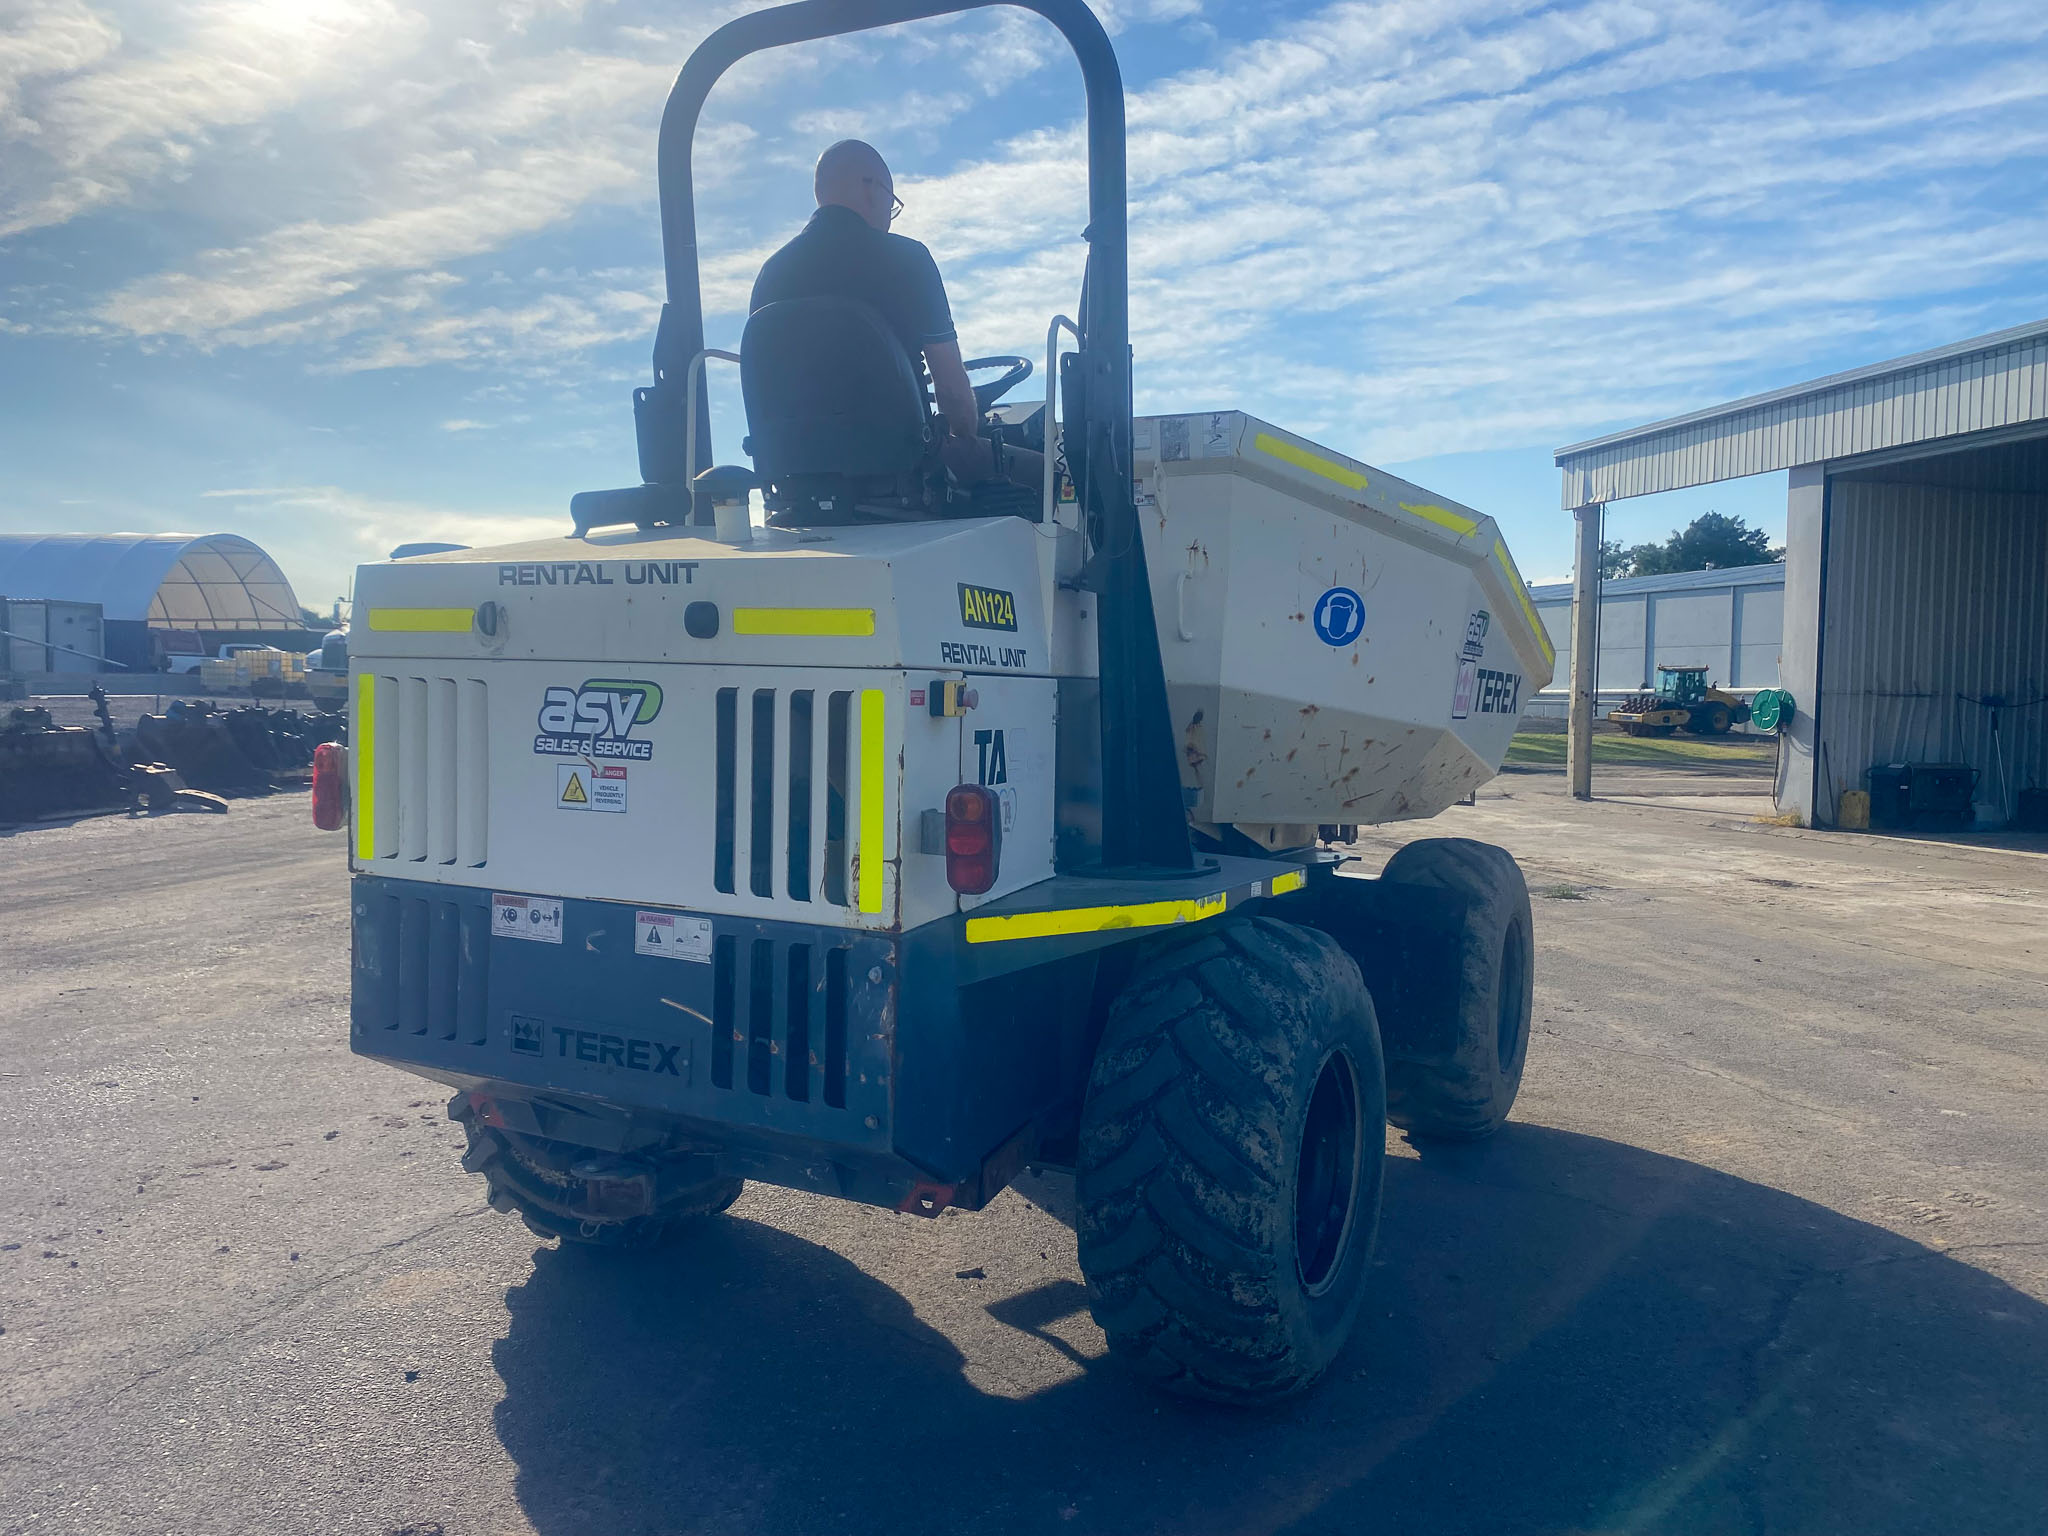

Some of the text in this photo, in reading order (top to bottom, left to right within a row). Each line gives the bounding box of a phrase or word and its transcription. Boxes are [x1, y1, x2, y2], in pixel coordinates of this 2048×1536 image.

[498, 562, 699, 586] RENTAL UNIT
[964, 587, 1014, 626] AN124
[940, 641, 1027, 668] RENTAL UNIT
[1474, 668, 1522, 714] TEREX
[580, 739, 590, 755] &
[595, 740, 651, 758] SERVICE
[552, 1026, 681, 1077] TEREX
